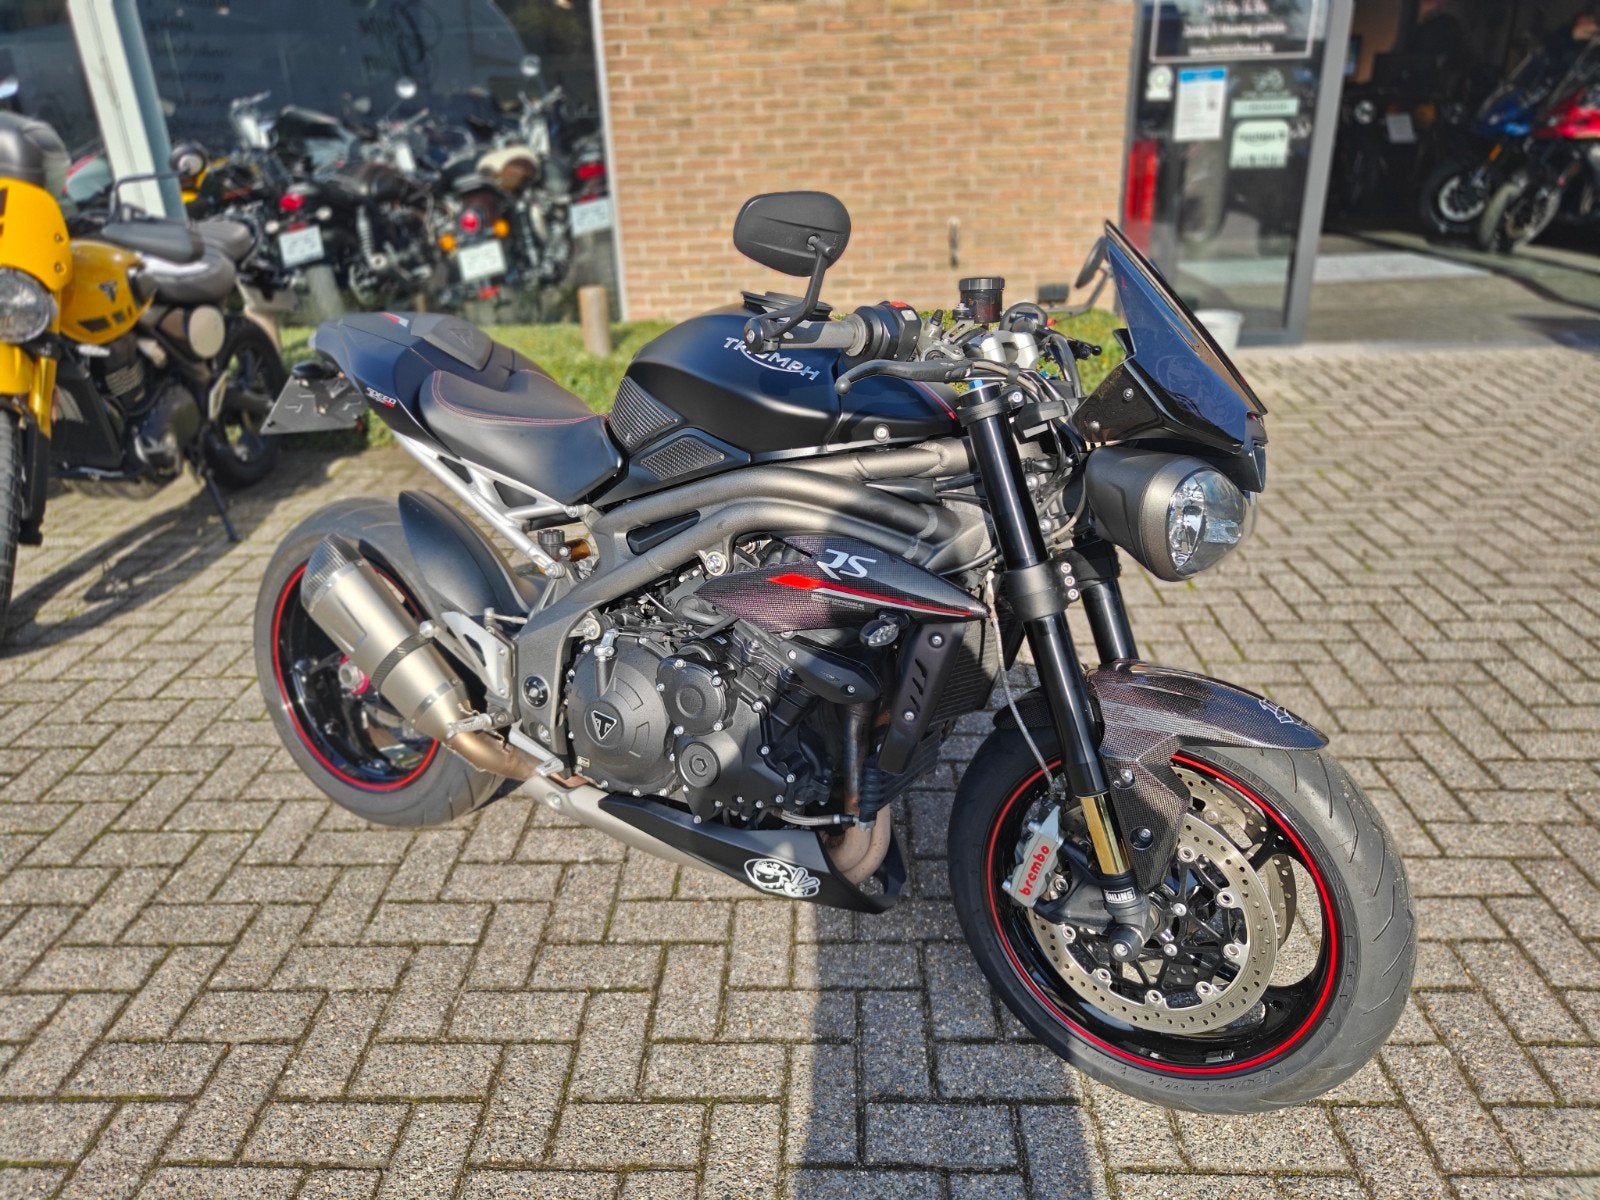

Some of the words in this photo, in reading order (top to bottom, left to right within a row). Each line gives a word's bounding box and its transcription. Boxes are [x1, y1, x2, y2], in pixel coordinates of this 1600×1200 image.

[723, 336, 820, 381] TRMPH
[817, 548, 876, 580] RS
[1019, 845, 1050, 896] brembo
